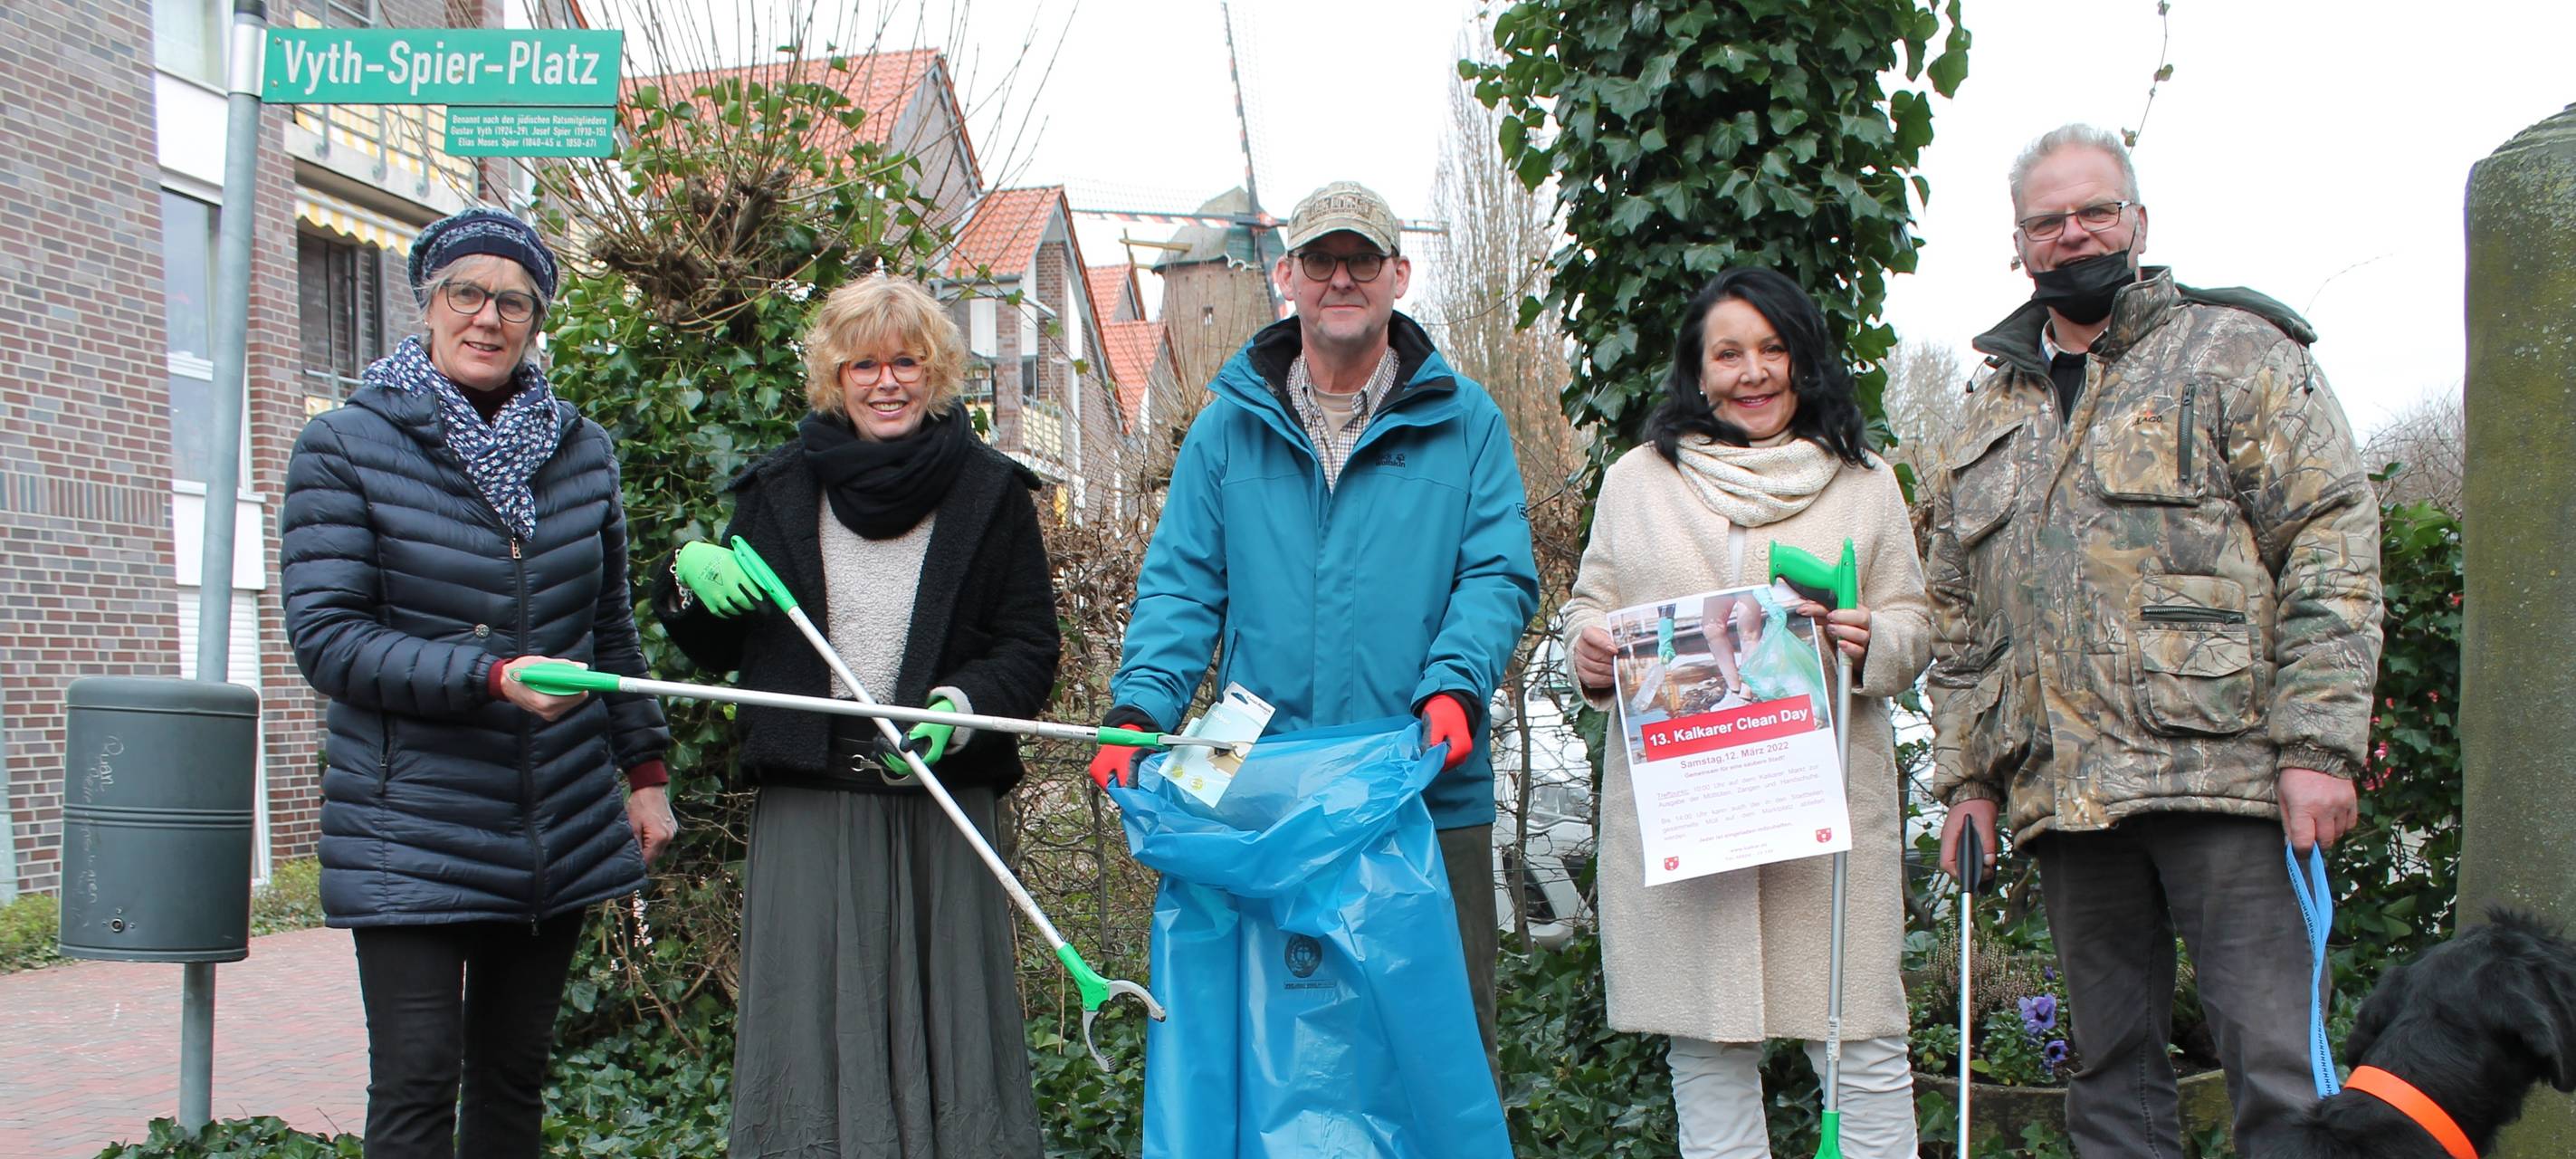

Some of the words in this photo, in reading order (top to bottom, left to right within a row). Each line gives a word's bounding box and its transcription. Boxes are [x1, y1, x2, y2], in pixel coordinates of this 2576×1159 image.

[284, 39, 600, 96] Vyth-Spier-Platz
[453, 115, 480, 123] Benannt
[501, 115, 514, 123] den
[518, 114, 550, 125] jüdischen
[552, 116, 606, 127] Ratsmitgliedern
[451, 126, 473, 135] Gustav
[478, 127, 492, 137] Vyth
[532, 127, 550, 135] Josef
[553, 127, 570, 137] Spier
[458, 138, 474, 147] Elias
[478, 138, 498, 147] Moses
[501, 138, 519, 148] Spier
[1650, 733, 1670, 745] 13.
[1674, 721, 1732, 741] Kalkarer
[1736, 712, 1777, 730] Clean
[1780, 706, 1808, 723] Day
[1741, 746, 1764, 757] März
[1766, 741, 1789, 752] 2022
